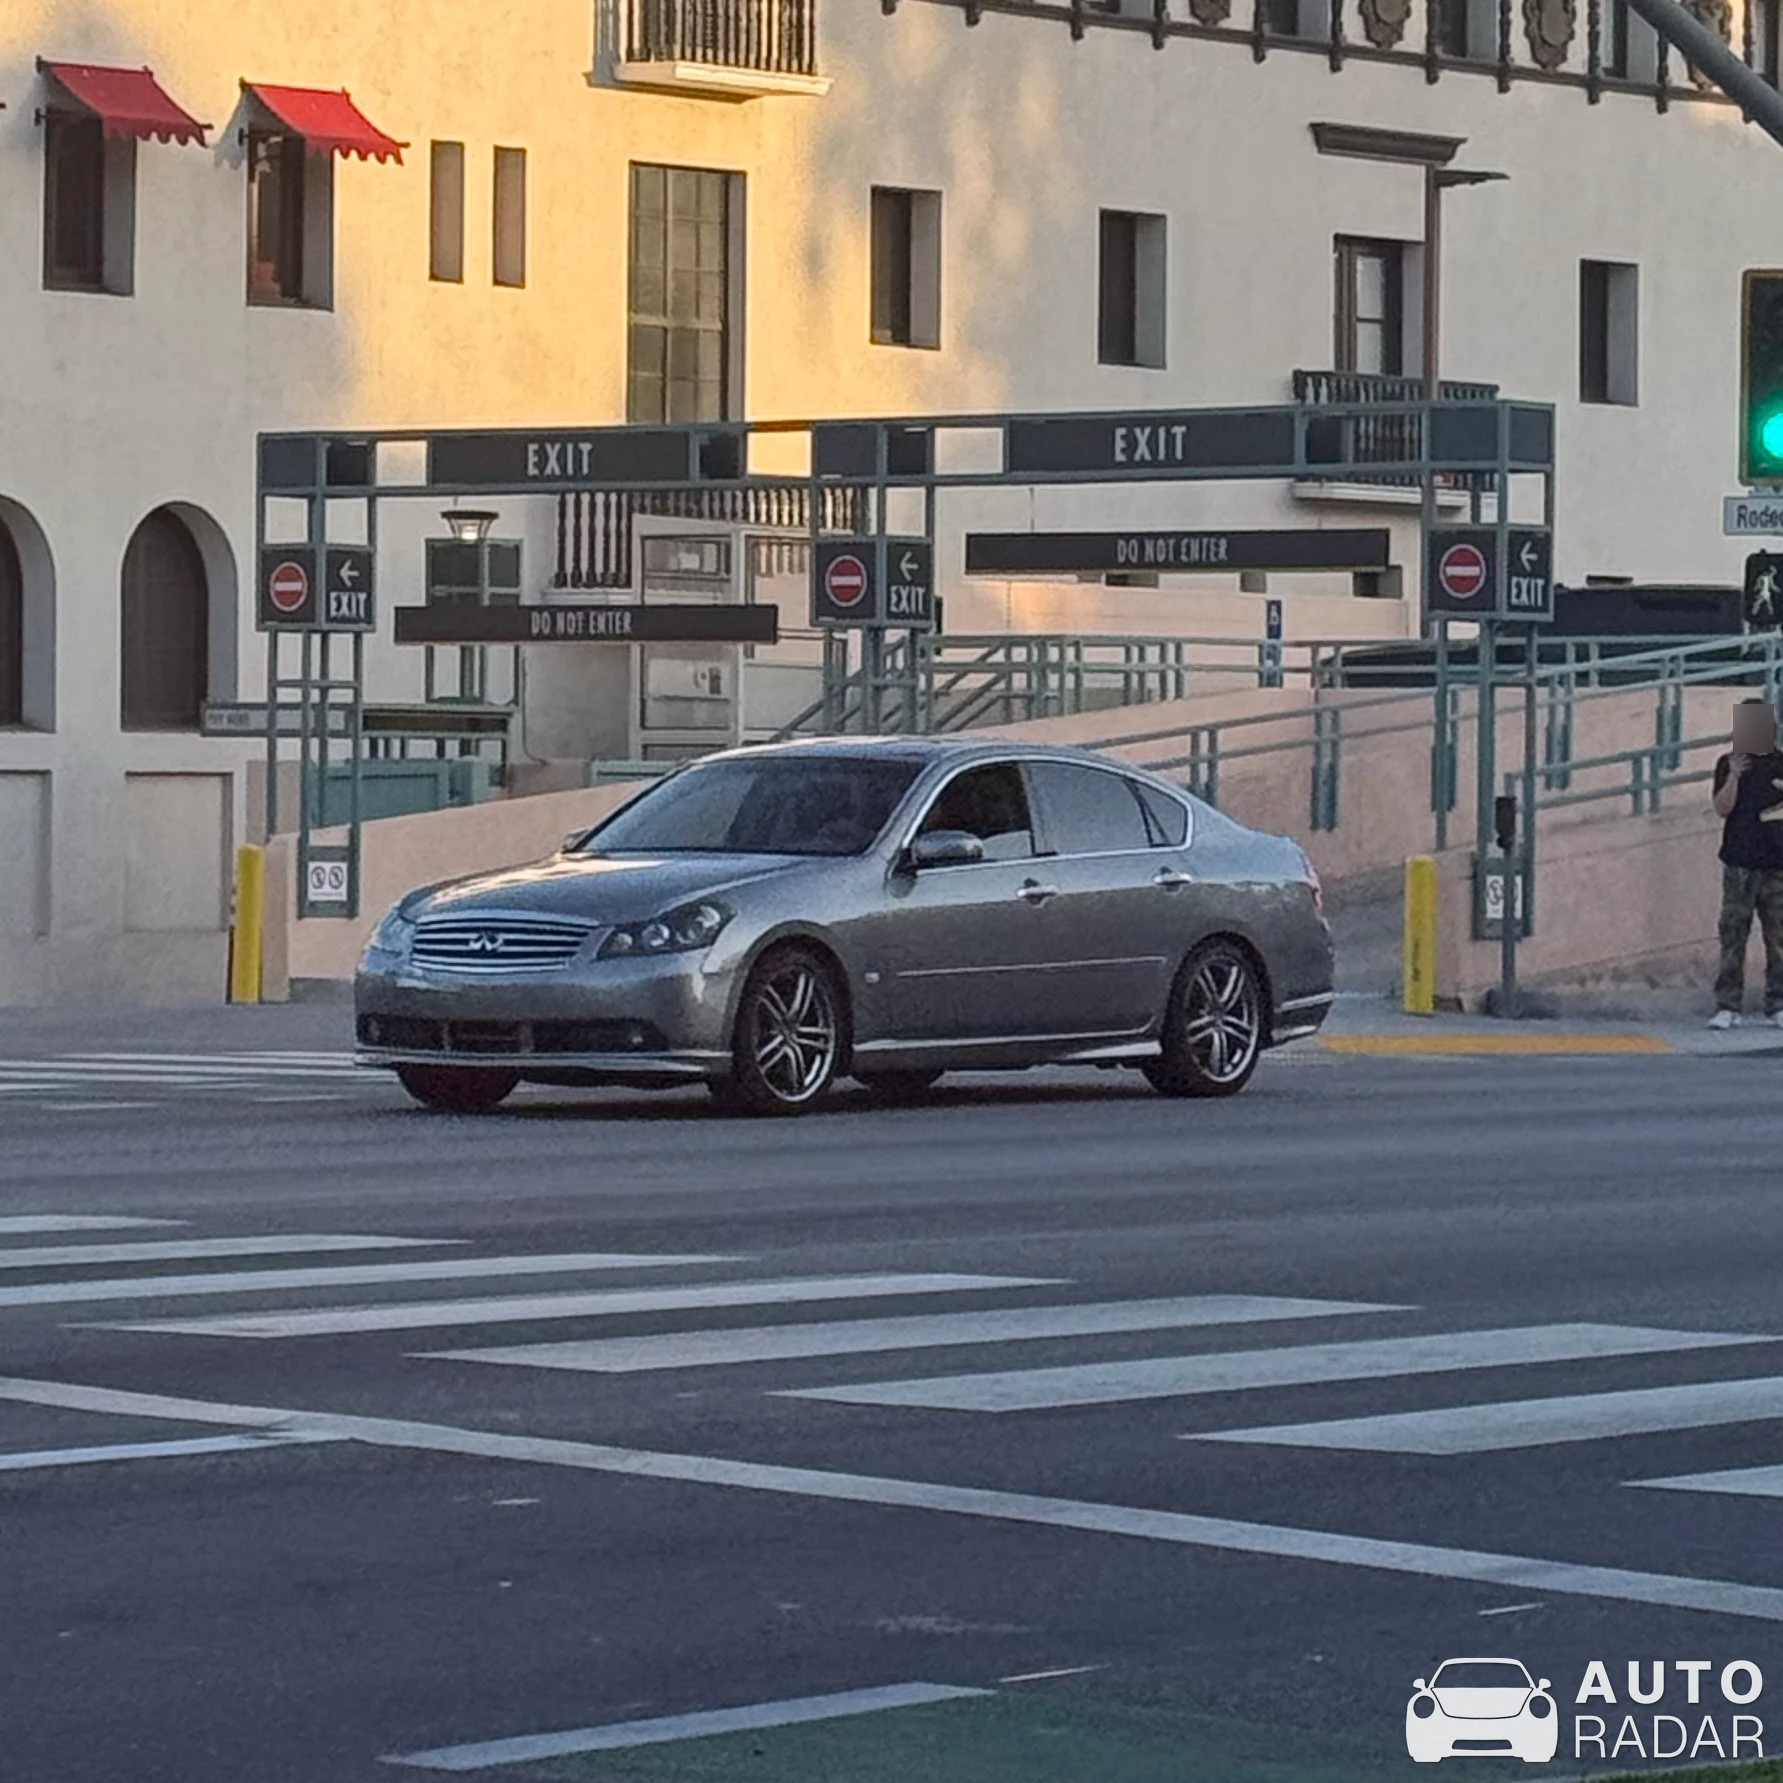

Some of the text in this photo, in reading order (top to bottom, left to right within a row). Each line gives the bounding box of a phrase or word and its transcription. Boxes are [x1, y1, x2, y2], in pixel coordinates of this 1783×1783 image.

[1114, 425, 1188, 463] EXIT
[526, 442, 593, 476] EXIT
[1117, 537, 1230, 563] DO NOT ENTER
[330, 591, 368, 619] EXIT
[890, 585, 926, 614] EXIT
[1511, 576, 1545, 607] EXIT
[531, 610, 633, 636] DO NOT ENTER
